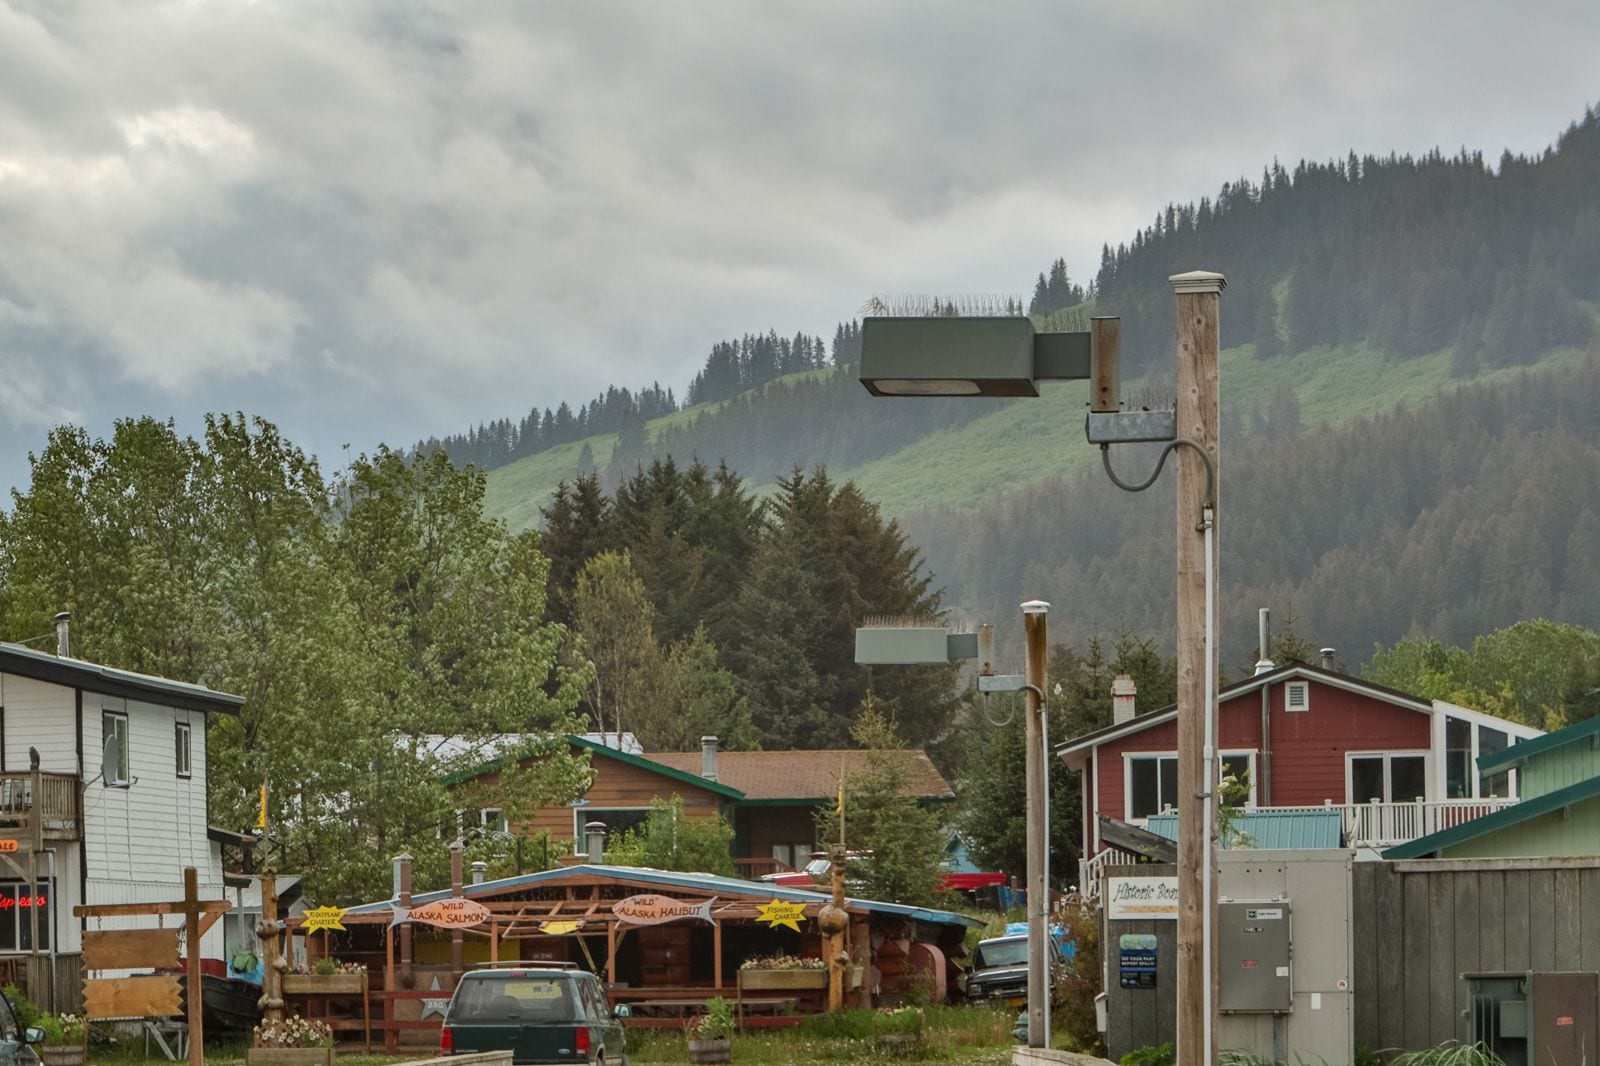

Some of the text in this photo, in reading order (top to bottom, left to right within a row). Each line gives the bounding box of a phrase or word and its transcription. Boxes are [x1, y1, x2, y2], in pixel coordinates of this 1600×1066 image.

[1112, 882, 1154, 902] Historic
[407, 911, 484, 924] ALASKA SALMON
[619, 906, 702, 919] ALASKA HALIBUT
